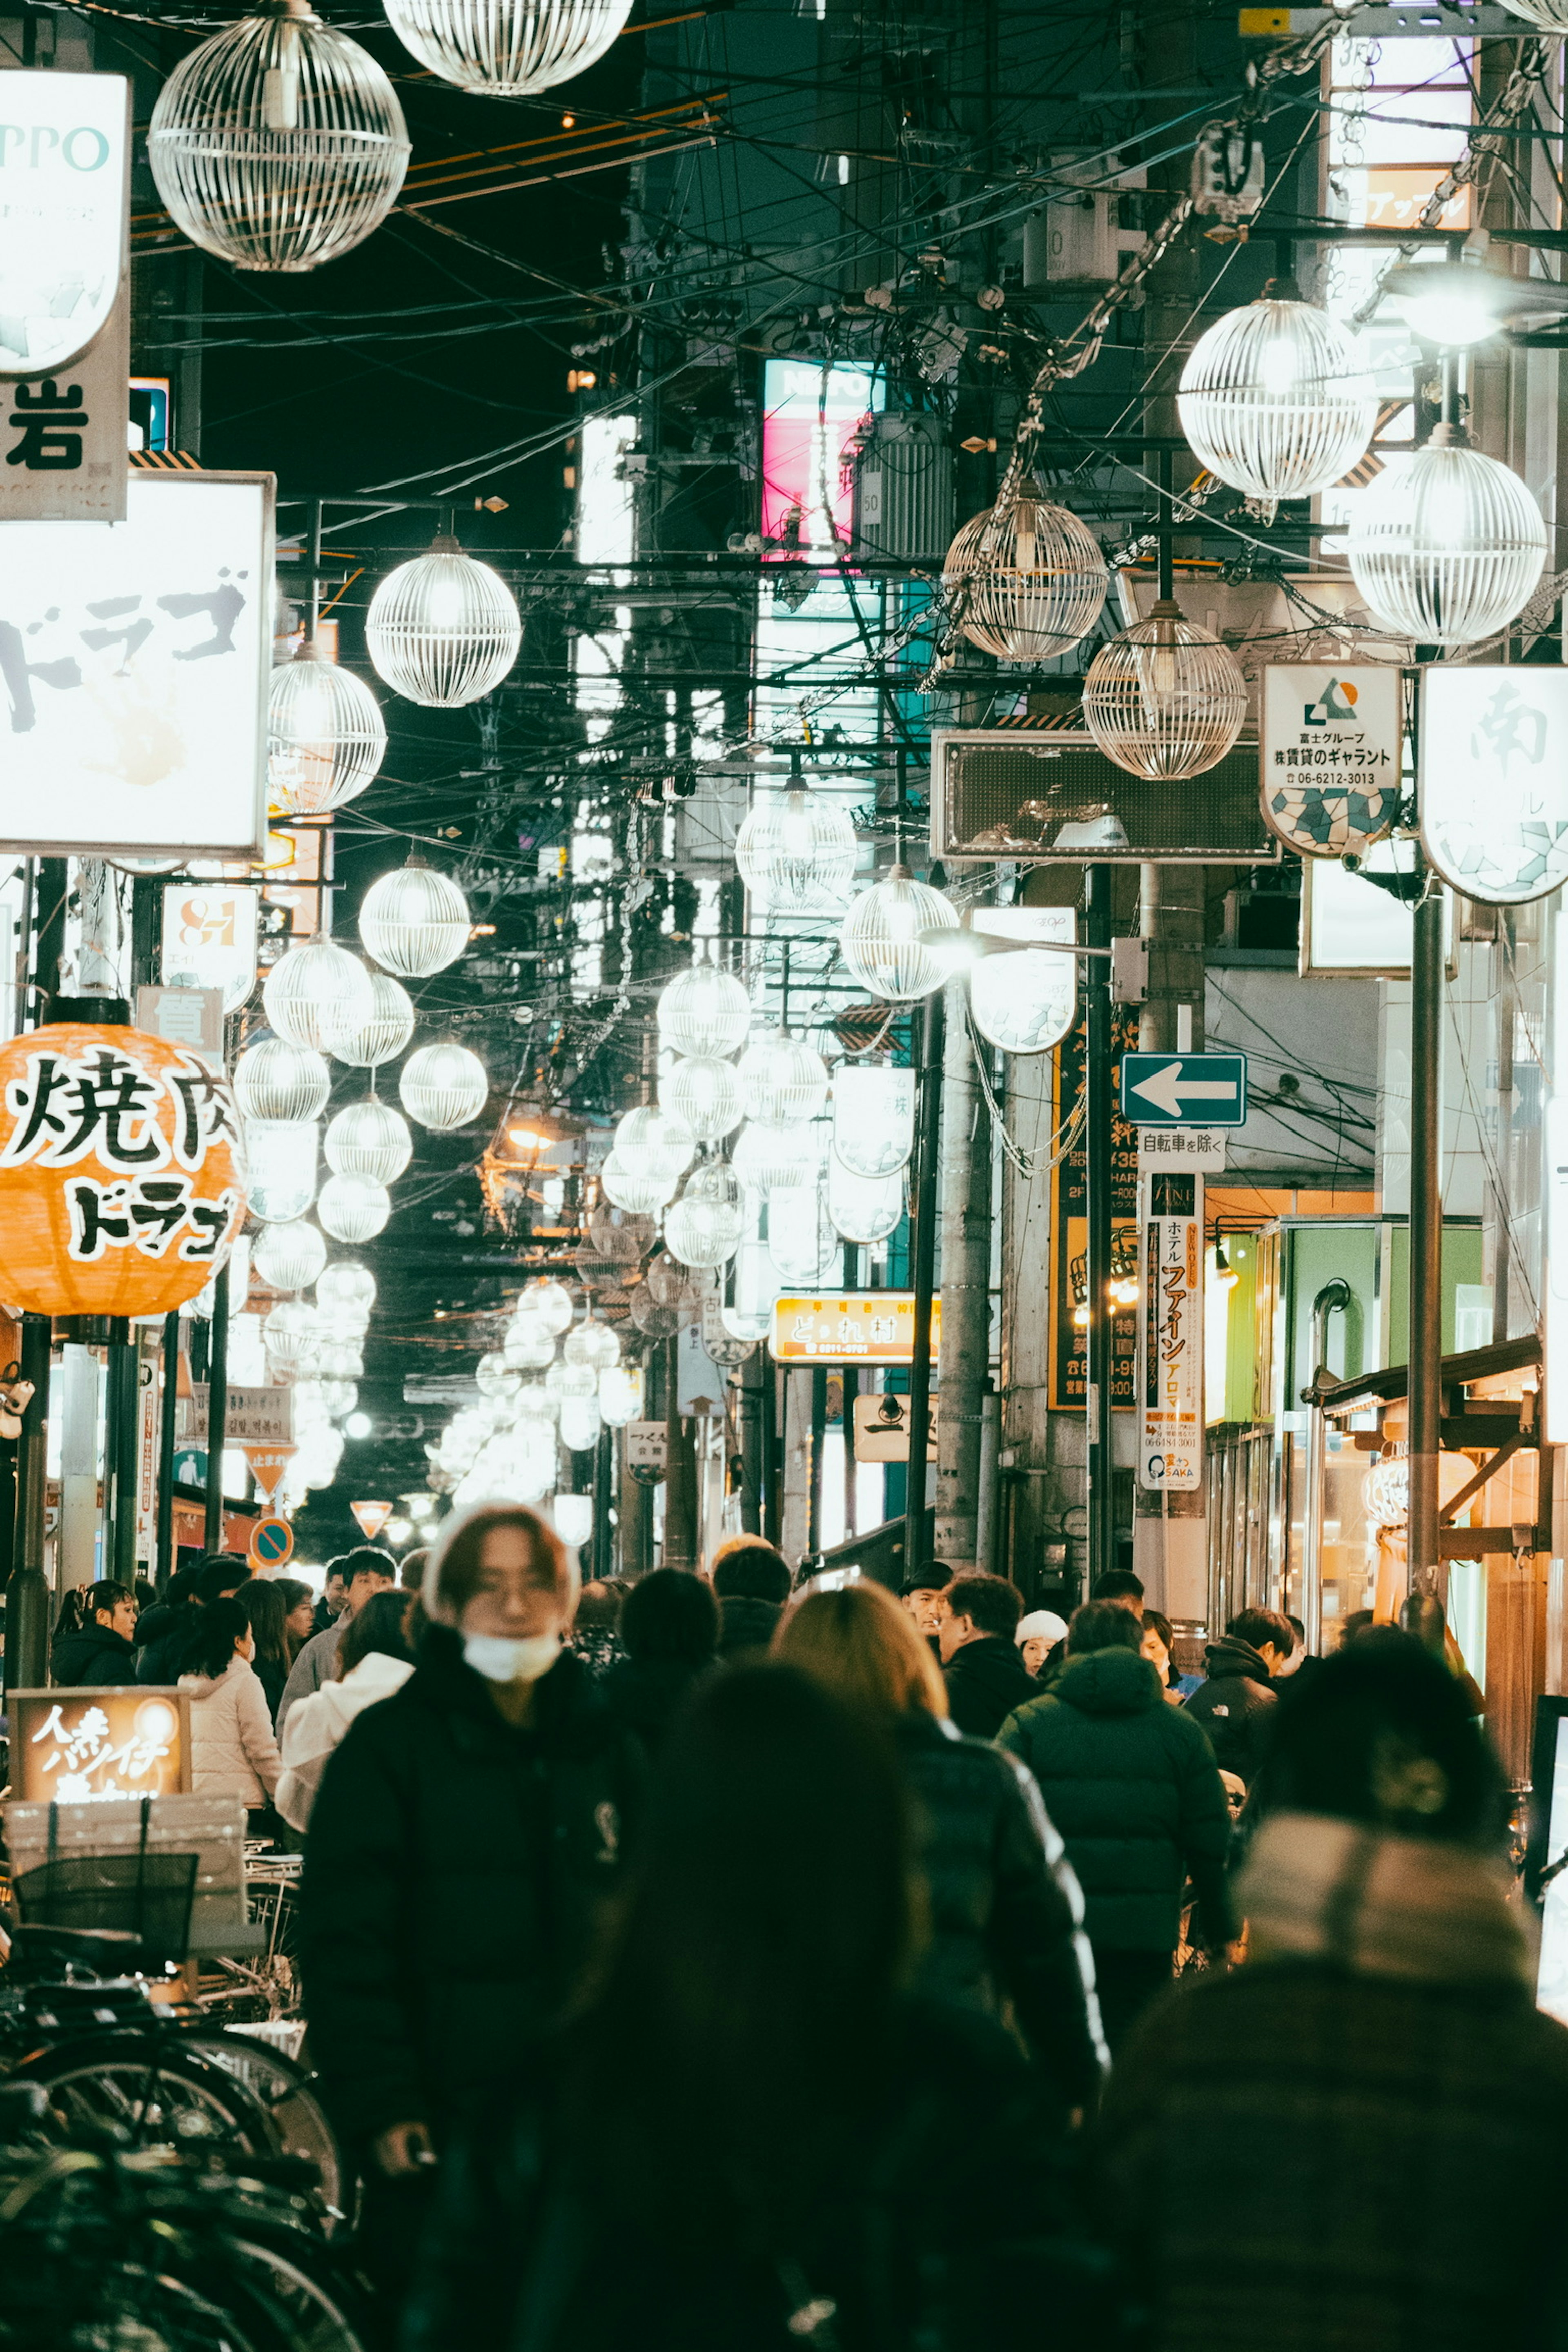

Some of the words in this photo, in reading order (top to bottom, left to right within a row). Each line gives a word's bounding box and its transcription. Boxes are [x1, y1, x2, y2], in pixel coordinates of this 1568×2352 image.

[6, 378, 89, 470] 岩
[864, 494, 878, 511] 50
[1300, 733, 1365, 744] 富士グループ
[1471, 680, 1548, 779] 南
[1298, 773, 1375, 784] 06-6212-3013
[1143, 1134, 1221, 1154] 自転車を除く
[1167, 1221, 1182, 1263] ホテル
[1188, 1226, 1196, 1251] NEW
[1187, 1254, 1196, 1286] OPEN
[1159, 1265, 1187, 1362] ファイン
[1166, 1364, 1181, 1408] アロマ
[252, 1454, 287, 1467] 止まれ
